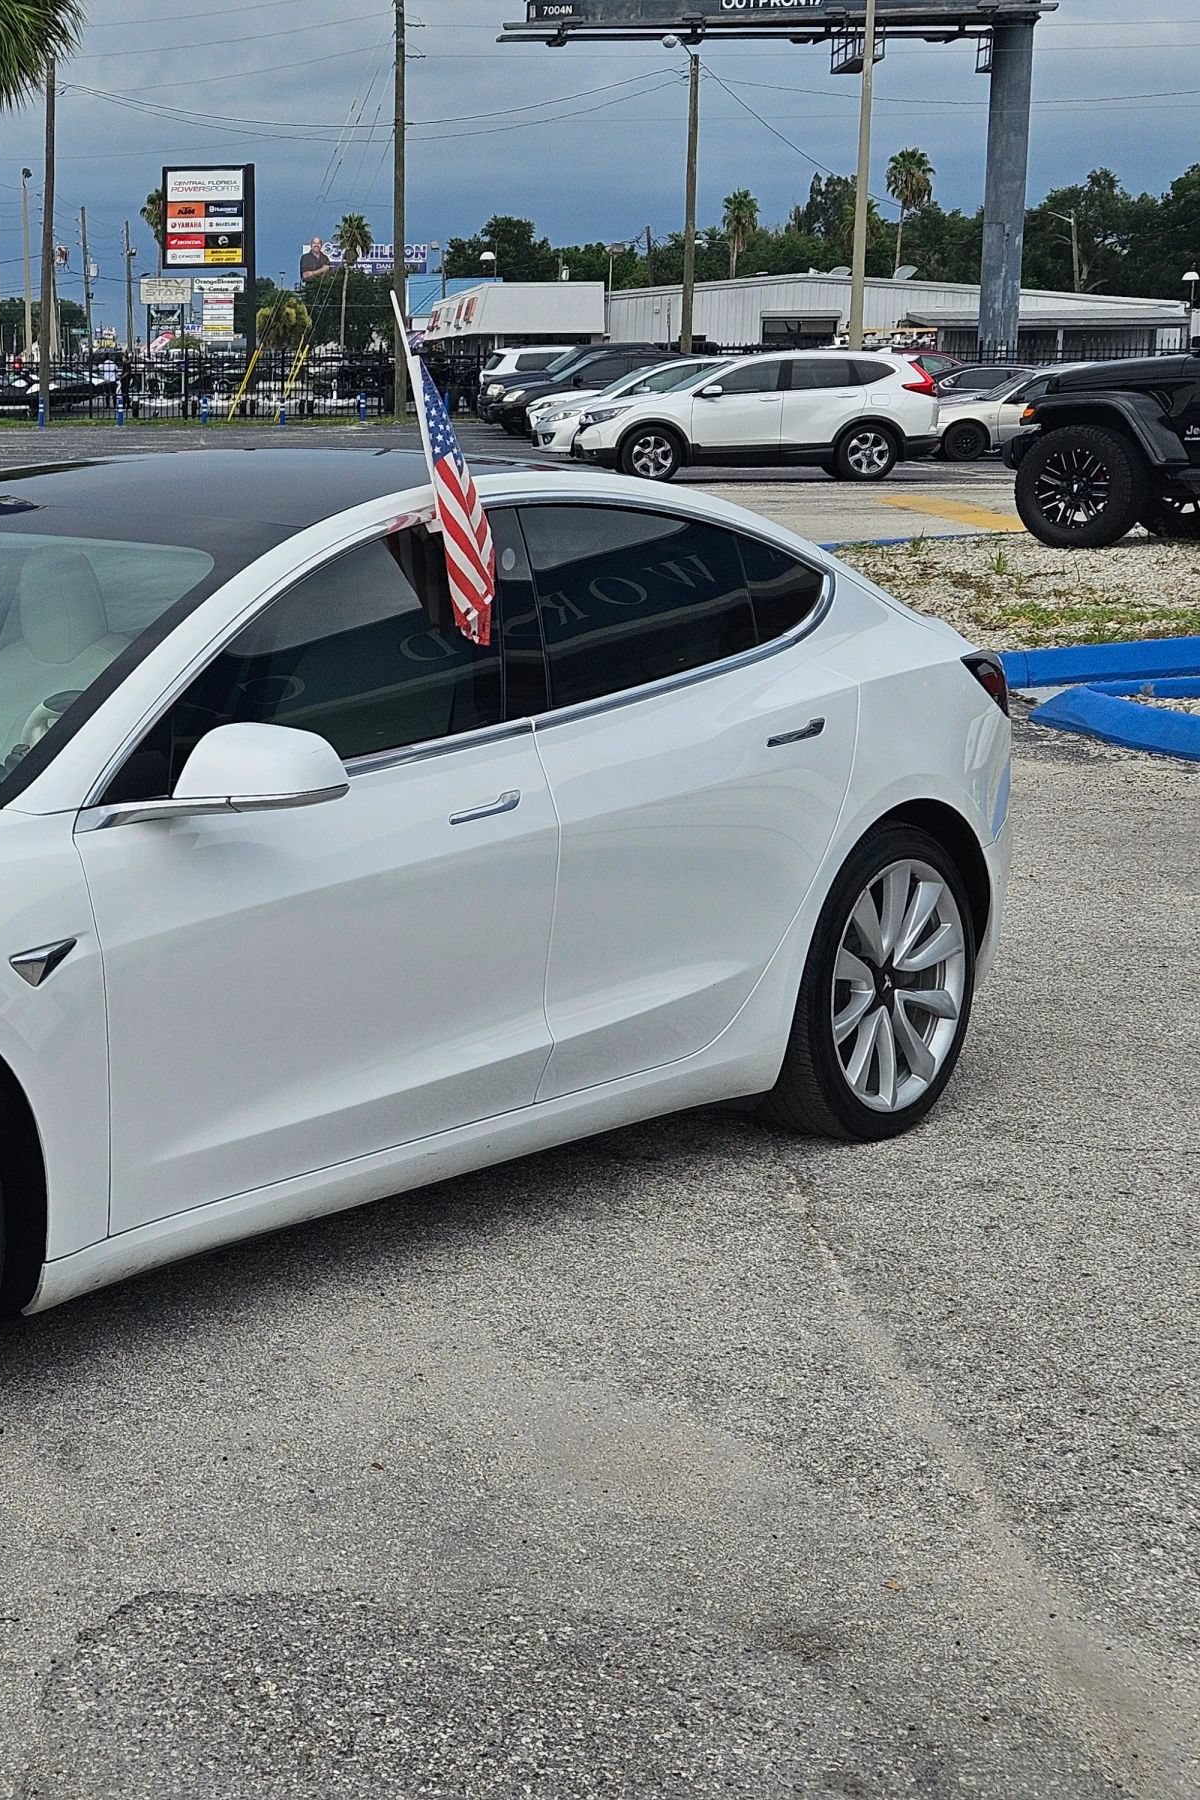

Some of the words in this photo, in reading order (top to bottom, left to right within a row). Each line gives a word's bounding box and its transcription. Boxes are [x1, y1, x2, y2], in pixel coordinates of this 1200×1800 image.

[542, 5, 573, 15] 7004N
[177, 207, 196, 215] KTM
[360, 243, 427, 260] MILLON
[145, 289, 186, 297] STAR
[1185, 425, 1200, 435] Je
